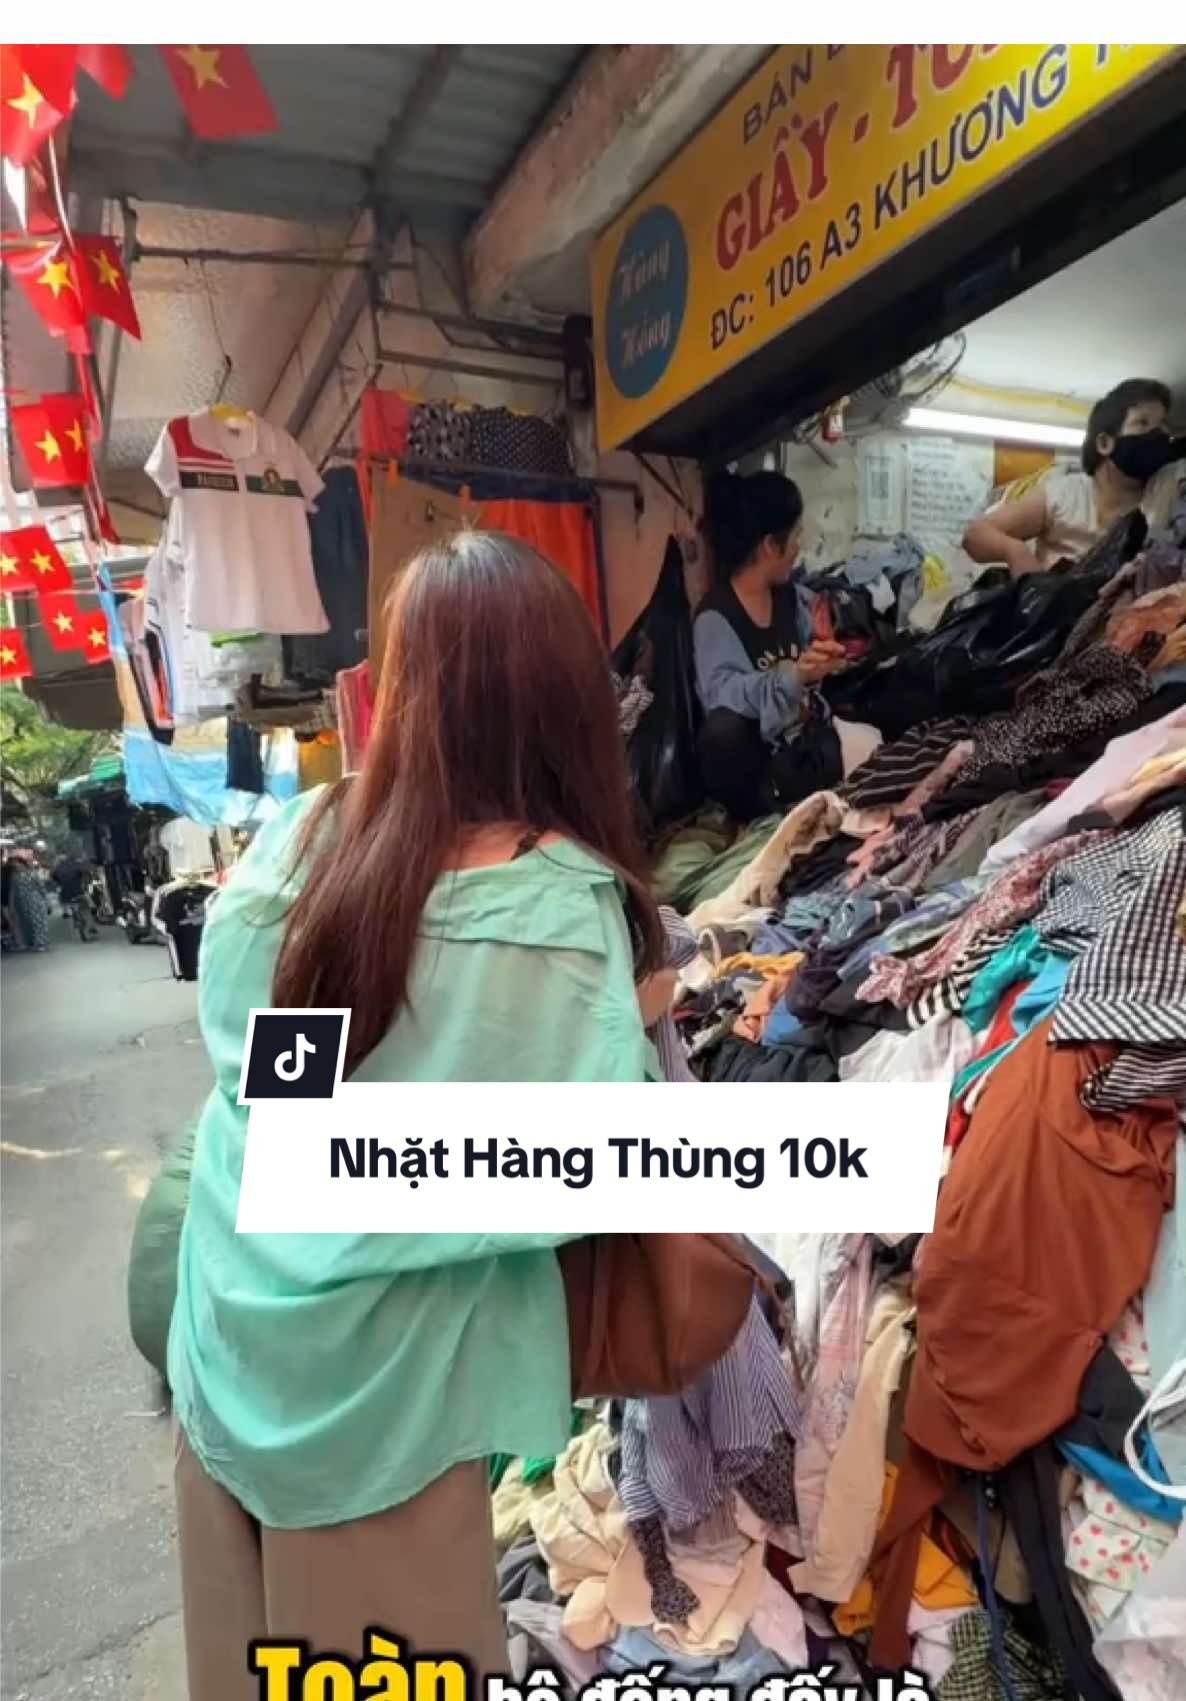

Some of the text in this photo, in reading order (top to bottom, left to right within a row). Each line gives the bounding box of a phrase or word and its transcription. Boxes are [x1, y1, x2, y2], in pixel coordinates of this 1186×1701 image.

[711, 44, 1067, 350] ĐC: 106 A3 KHƯƠNG
[743, 47, 813, 145] BÁN
